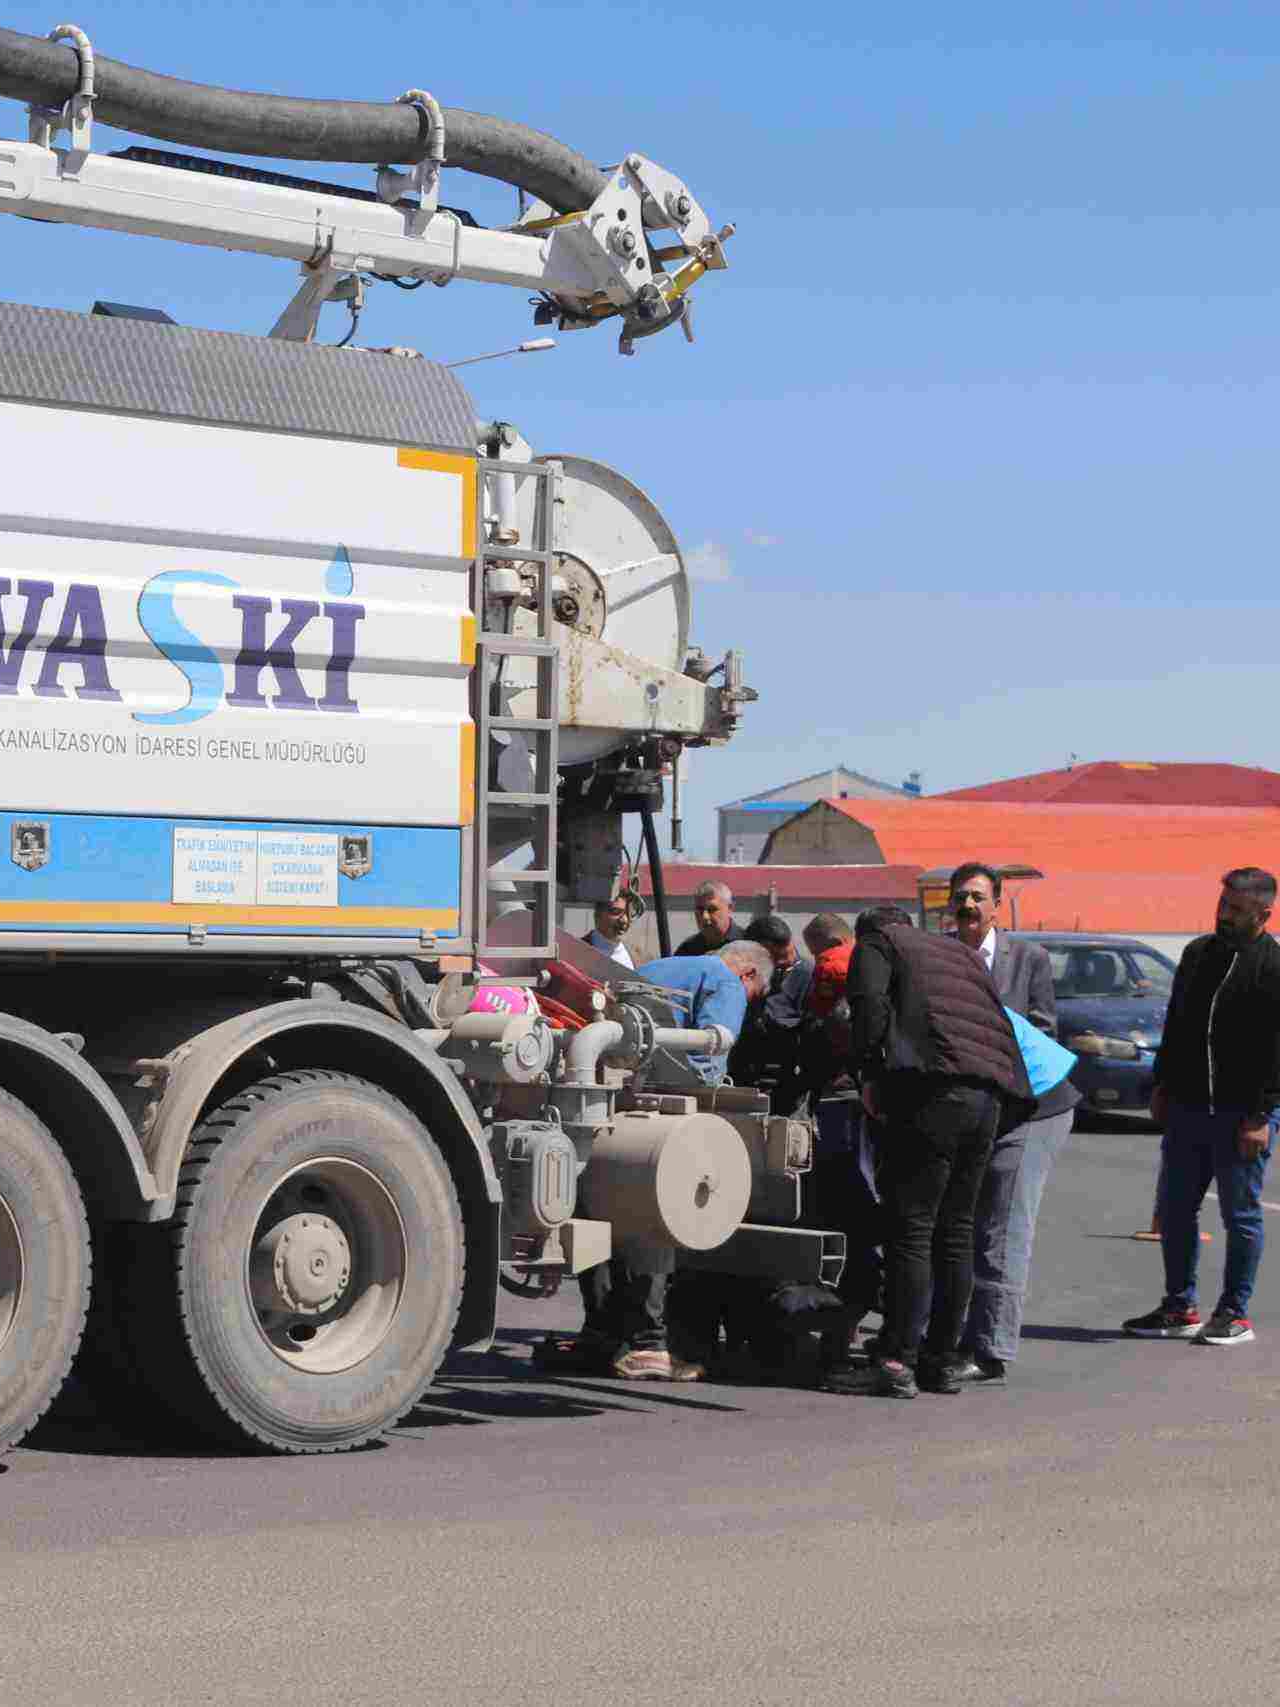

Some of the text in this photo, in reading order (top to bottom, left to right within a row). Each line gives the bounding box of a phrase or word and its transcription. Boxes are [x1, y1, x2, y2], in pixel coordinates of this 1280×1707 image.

[136, 733, 201, 757] İDARESİ
[207, 739, 260, 760] GENEL
[265, 740, 367, 765] MÜDÜRLÜĞÜ
